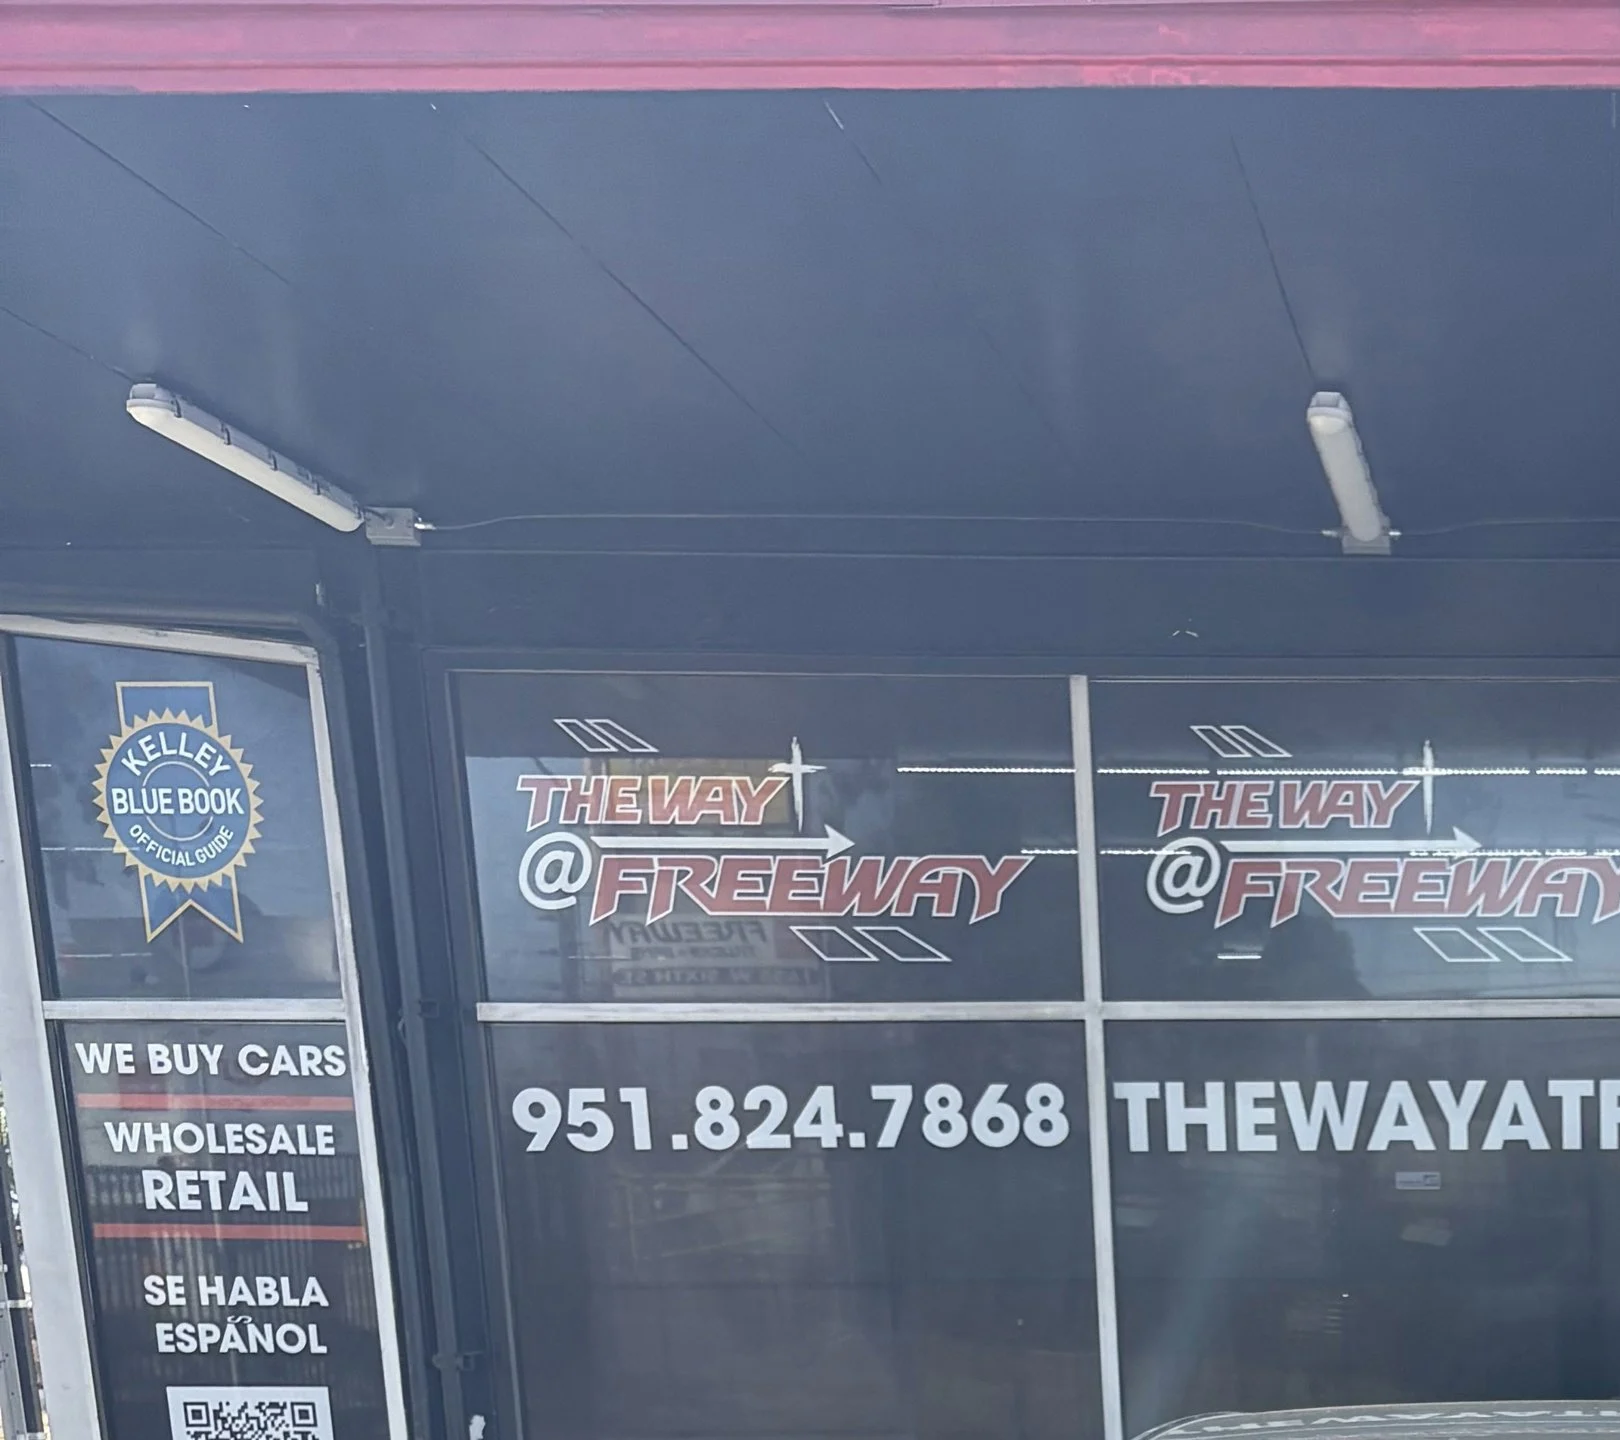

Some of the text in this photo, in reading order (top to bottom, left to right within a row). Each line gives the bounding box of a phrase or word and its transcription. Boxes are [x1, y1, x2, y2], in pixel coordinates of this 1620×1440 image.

[121, 731, 231, 777] KELLEY
[112, 787, 244, 815] BLUE BOOK
[129, 824, 234, 867] OFFICIAL GUIDE
[75, 1043, 347, 1078] WE BUY CARS
[511, 1083, 1070, 1153] 951.824.7868
[104, 1122, 336, 1157] WHOLESALE
[142, 1169, 309, 1214] RETAIL
[144, 1275, 330, 1308] SE HABLA
[155, 1314, 328, 1355] ESPAÑOL
